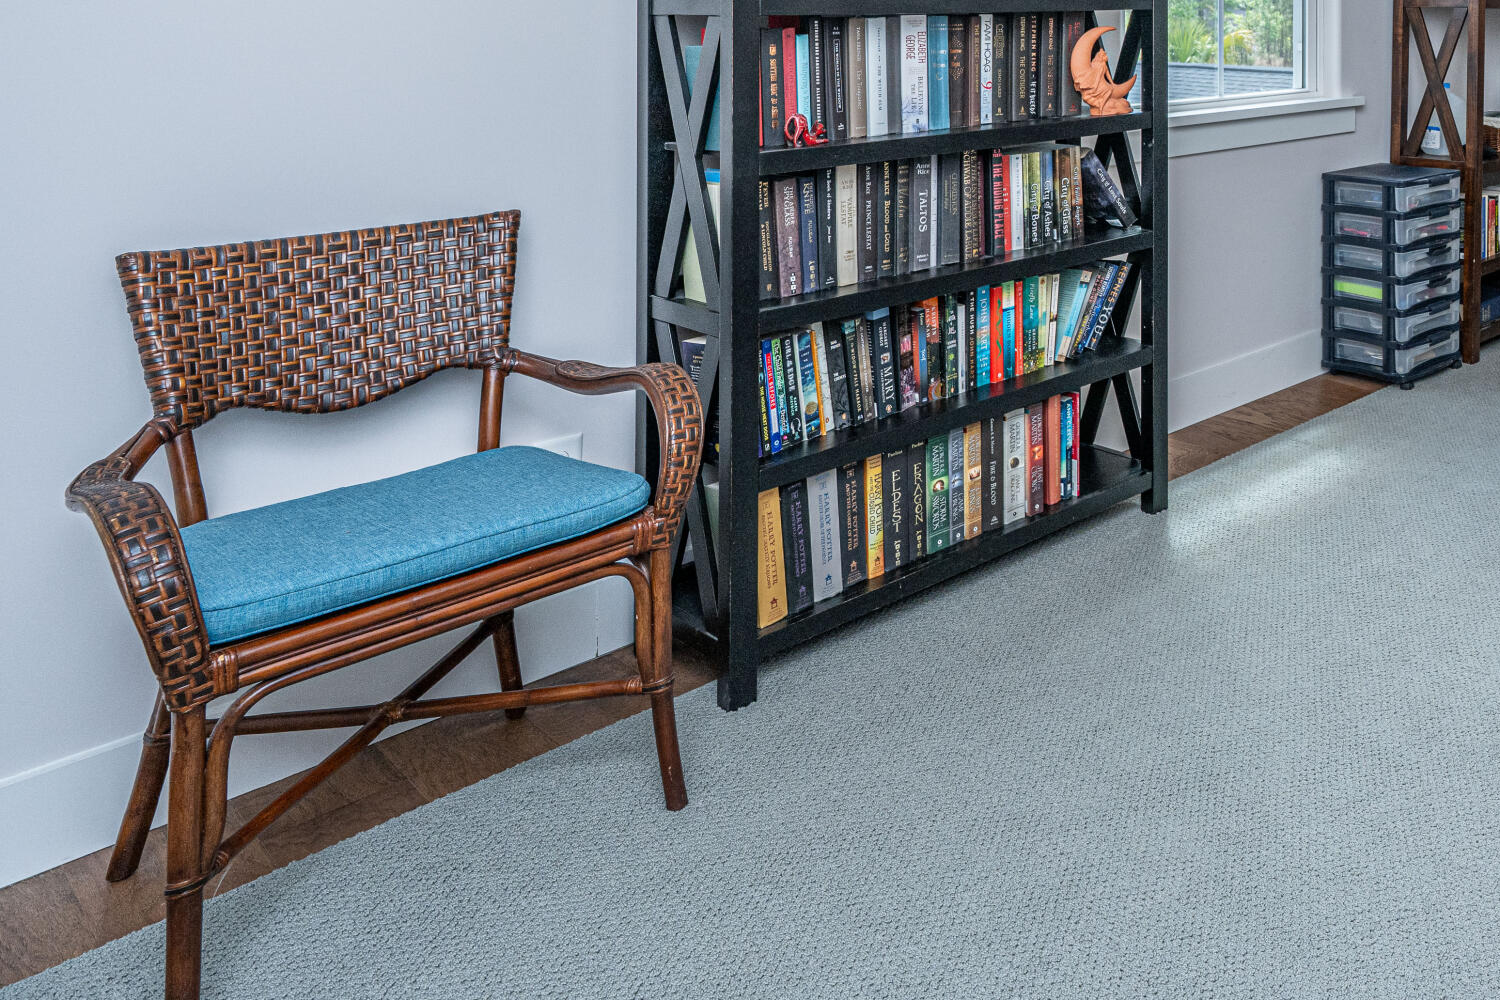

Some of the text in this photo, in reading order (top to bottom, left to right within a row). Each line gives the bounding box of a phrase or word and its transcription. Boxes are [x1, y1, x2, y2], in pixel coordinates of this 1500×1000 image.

[906, 34, 916, 60] GEORGE
[917, 31, 927, 64] ELIZABETH
[984, 18, 992, 73] TAMI HOAG
[963, 151, 971, 185] SCHWAB
[803, 183, 811, 215] KNIFE
[898, 188, 909, 219] Violin
[992, 163, 1004, 240] THE HIDING PLACE
[1030, 183, 1039, 204] City
[1060, 176, 1071, 234] City of Glass
[1096, 168, 1106, 183] City
[1107, 186, 1118, 199] Lost
[1116, 198, 1128, 214] Souls
[918, 189, 928, 233] TALTOS
[964, 186, 972, 261] OF ADDIE LARUE
[1043, 180, 1052, 238] City of Ashes
[1074, 205, 1082, 226] Angels
[1031, 214, 1040, 243] Bones
[1108, 264, 1128, 304] KEPNES
[980, 298, 988, 351] JOHN HART
[1094, 305, 1113, 335] YOU
[784, 340, 796, 392] GIRL EDGE
[883, 366, 895, 400] MARY
[1030, 416, 1038, 446] MARTIN
[932, 445, 940, 477] MARTIN
[968, 435, 976, 466] MARTIN
[892, 469, 902, 533] ELDEST
[913, 462, 924, 526] ERAGON
[939, 496, 947, 522] STORM
[875, 502, 883, 536] POTTER
[932, 496, 940, 530] SWORDS
[766, 512, 778, 586] HARRY POTTER
[795, 501, 803, 535] HARRY
[799, 540, 807, 575] POTTER
